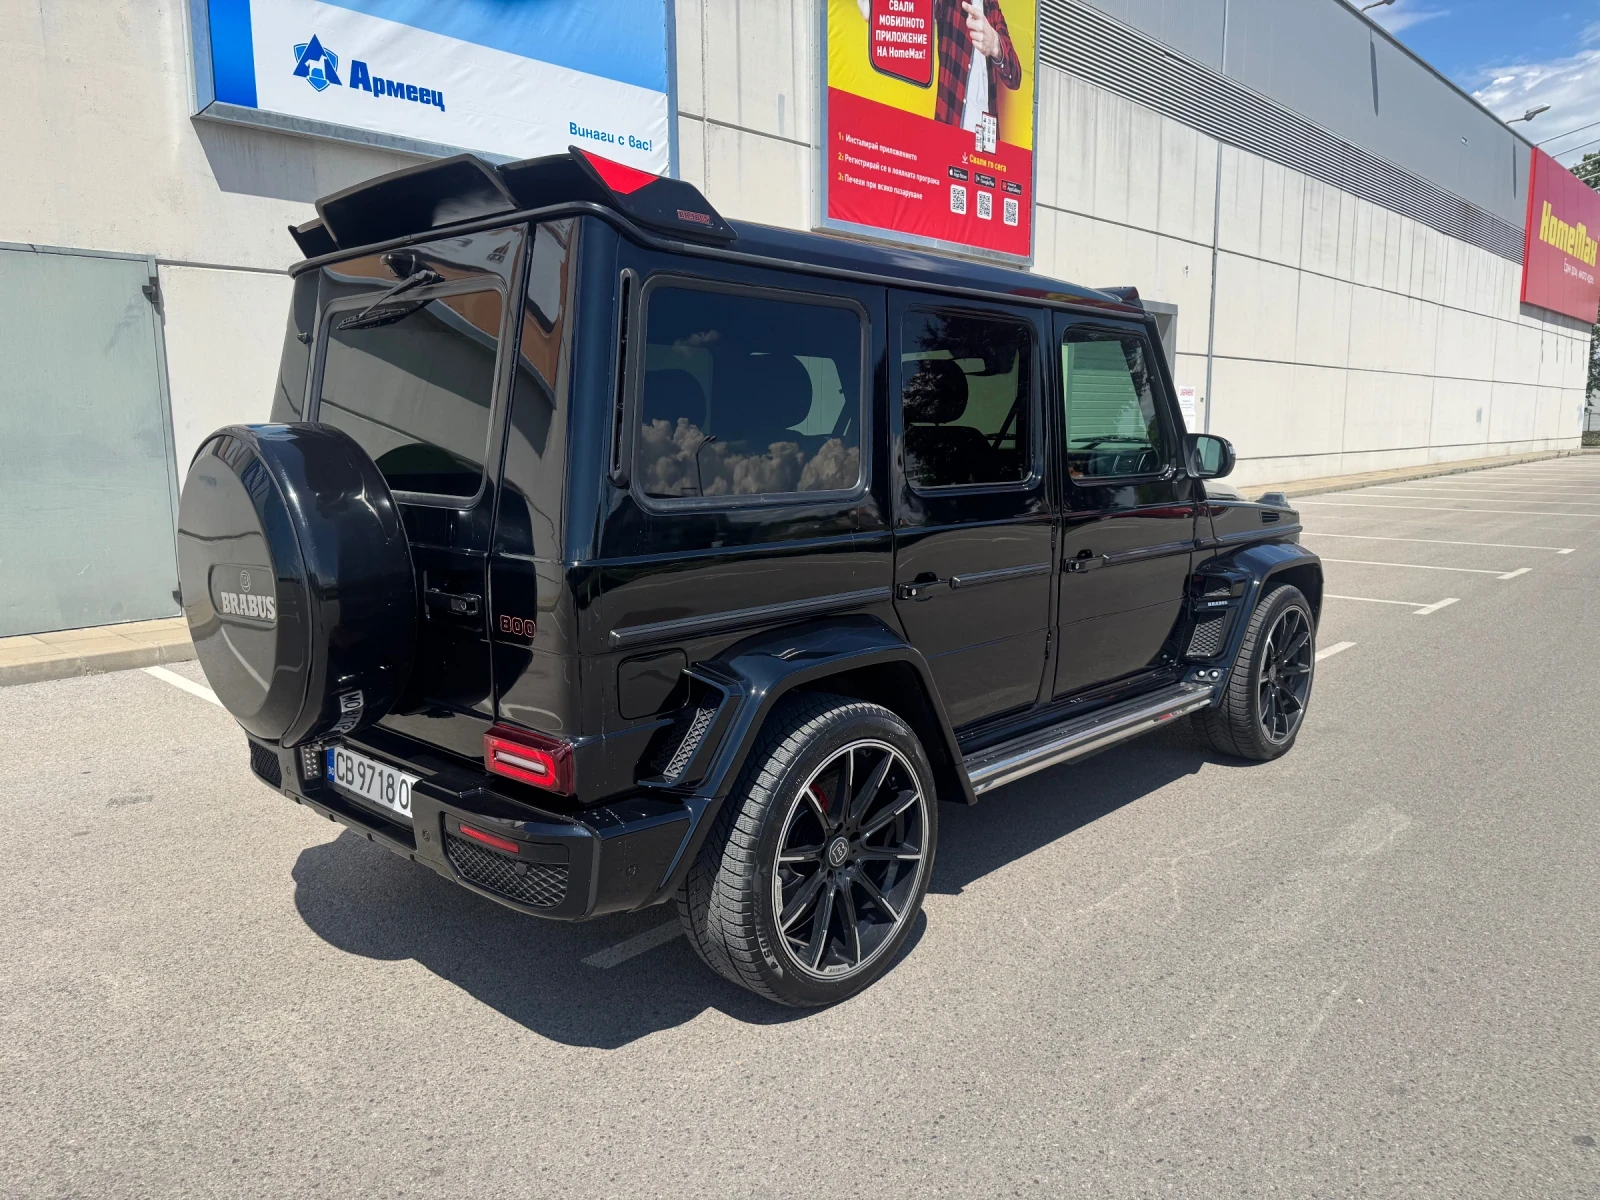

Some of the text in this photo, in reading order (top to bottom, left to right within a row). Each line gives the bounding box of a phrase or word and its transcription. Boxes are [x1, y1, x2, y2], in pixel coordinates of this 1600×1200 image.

[889, 0, 914, 13] СВАЛИ
[879, 14, 925, 29] МОБИЛНОТО
[875, 29, 928, 45] ПРИЛОЖЕНИЕ
[876, 46, 926, 59] НА HomeMax!
[349, 59, 446, 113] Армеец
[569, 121, 652, 152] Винаги с вас!
[838, 131, 918, 161] 1: Инсталирай приложението
[838, 152, 844, 161] 2:
[844, 153, 880, 170] Регистрирай
[892, 167, 916, 179] лоялната
[916, 174, 940, 185] програма
[969, 153, 1007, 173] Свали го сега
[838, 172, 923, 200] 3: Печели при всяко пазаруване
[1539, 200, 1598, 268] HomeMax
[221, 591, 276, 619] BRABUS
[500, 615, 536, 638] 800
[336, 752, 413, 811] CB 9718 O
